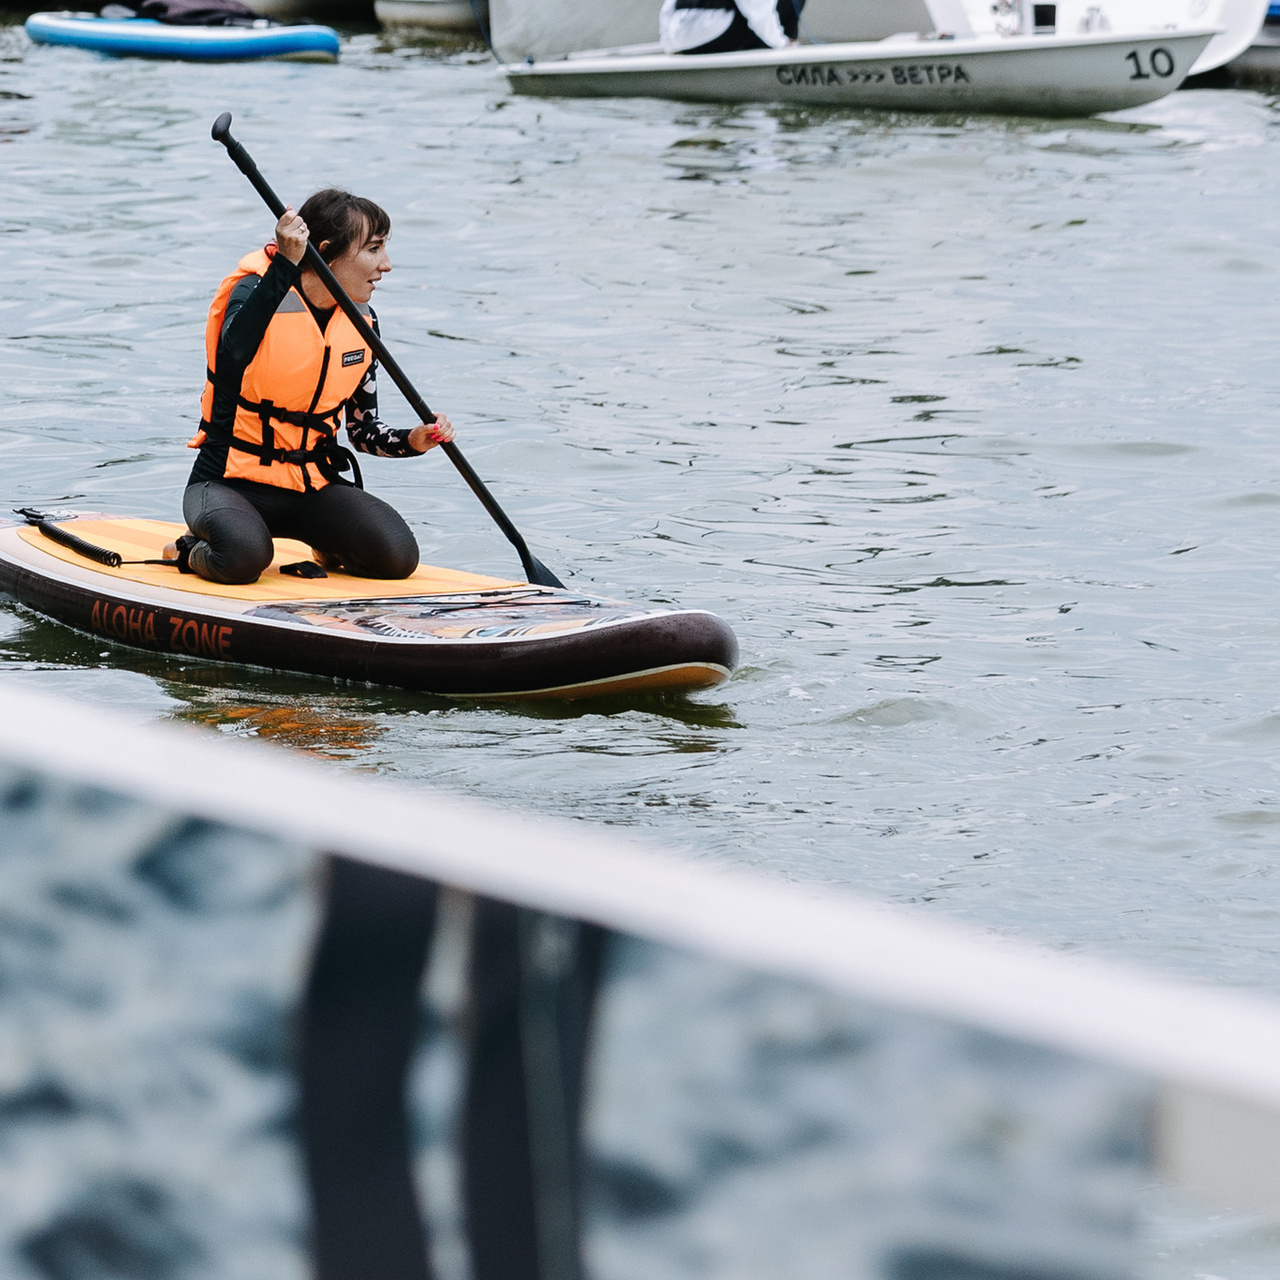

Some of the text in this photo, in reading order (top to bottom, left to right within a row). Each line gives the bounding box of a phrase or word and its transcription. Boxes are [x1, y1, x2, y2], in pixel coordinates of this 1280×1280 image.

[776, 63, 971, 86] СИЛА ВЕТРА
[1125, 48, 1175, 80] 10
[91, 600, 233, 659] ALOHA ZONE
